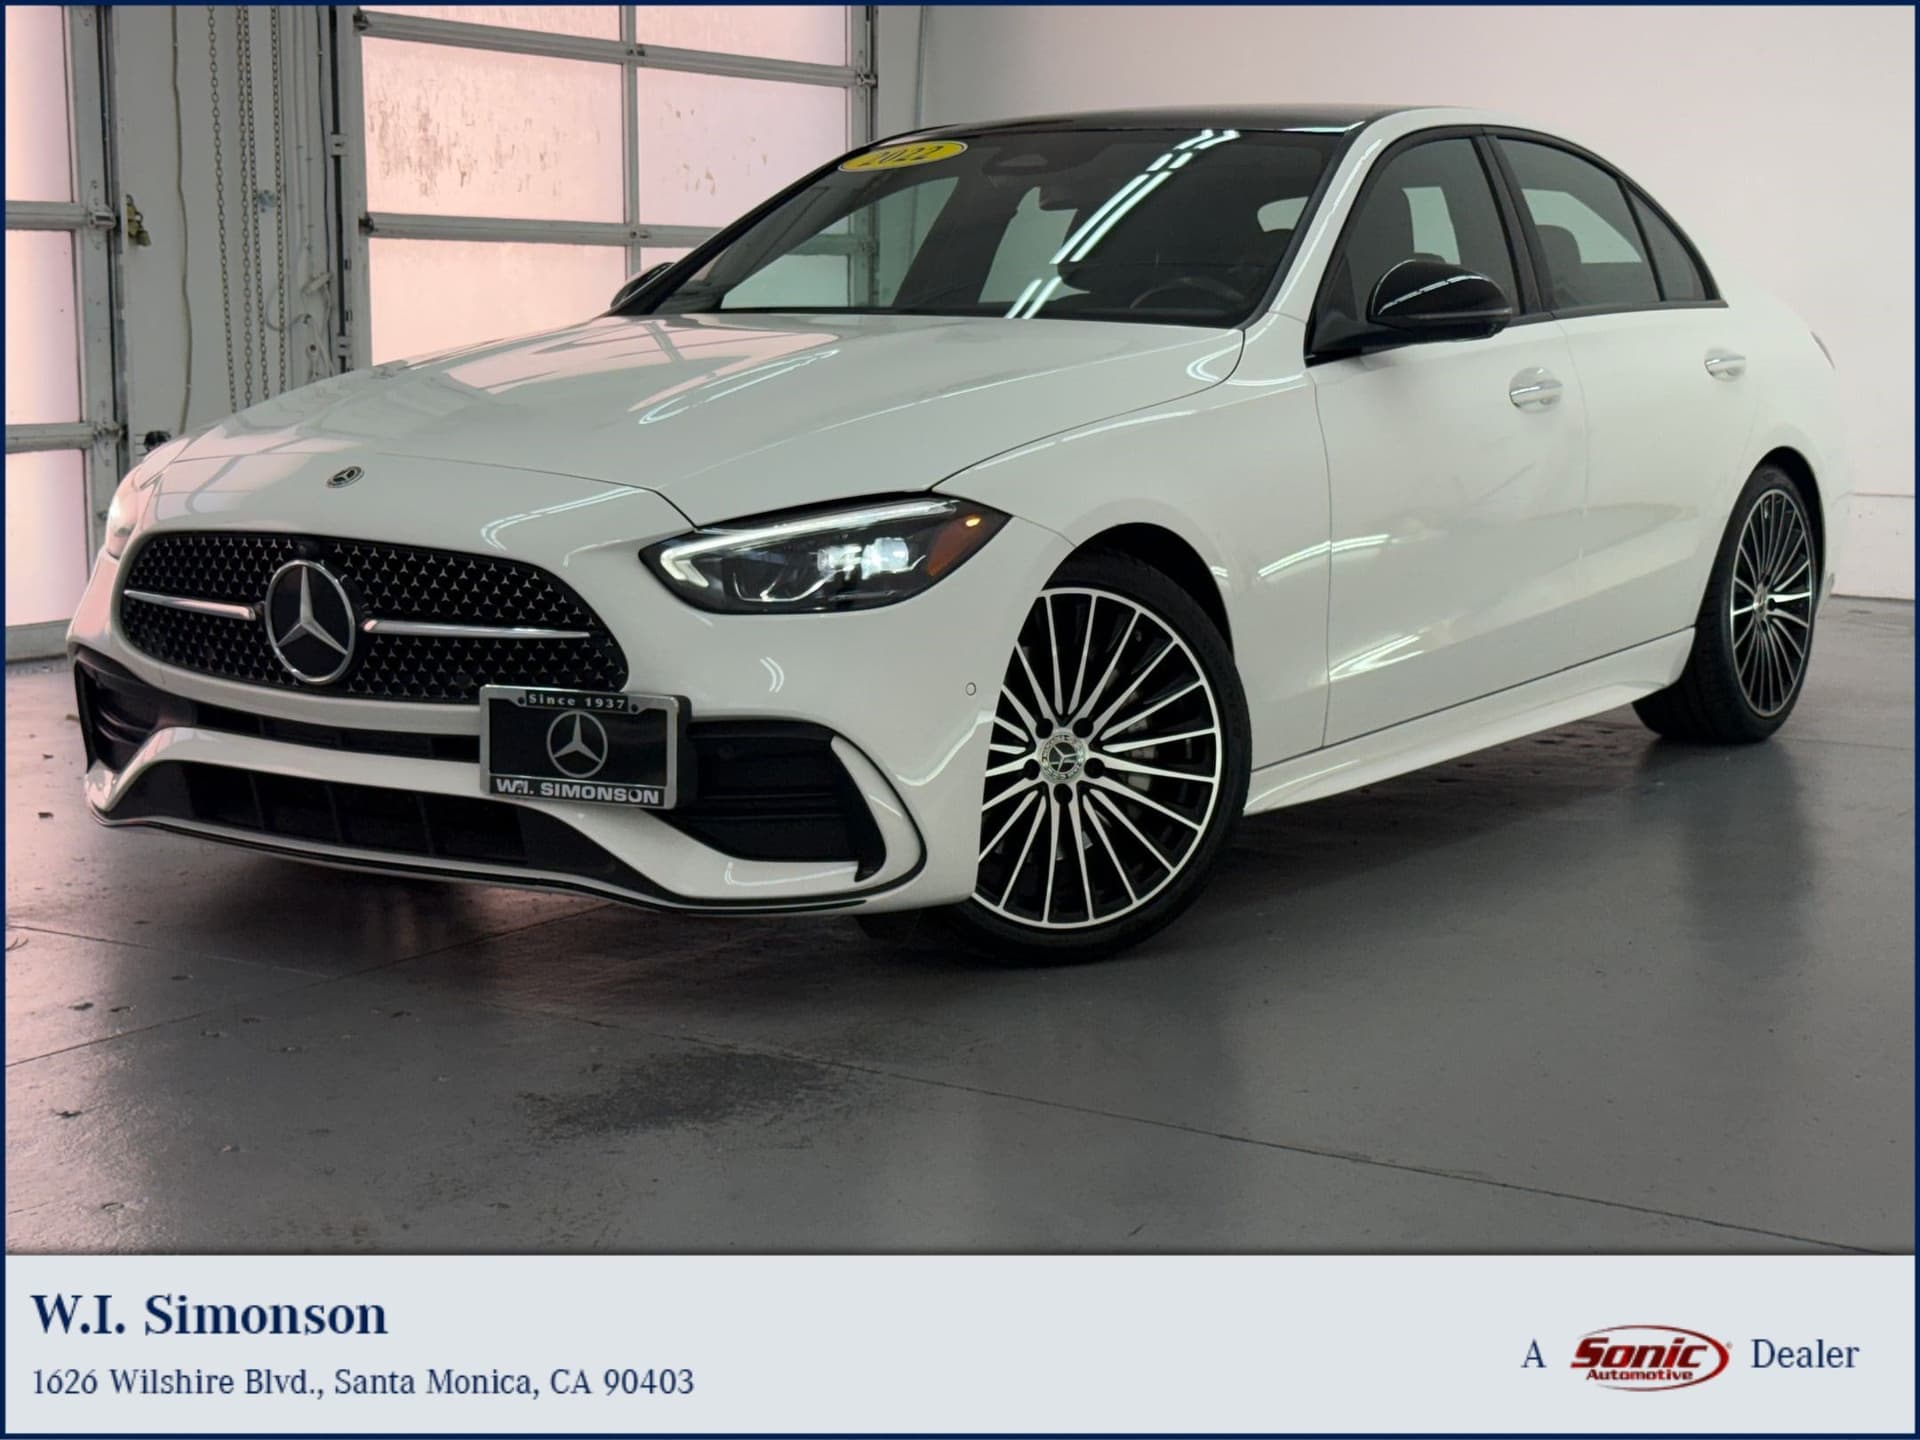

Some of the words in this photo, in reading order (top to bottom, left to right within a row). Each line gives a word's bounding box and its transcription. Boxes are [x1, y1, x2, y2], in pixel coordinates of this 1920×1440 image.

[857, 145, 945, 167] 2022
[529, 693, 576, 706] Since
[585, 697, 625, 709] 1937
[496, 779, 534, 795] W.I.
[540, 782, 659, 804] SIMONSON
